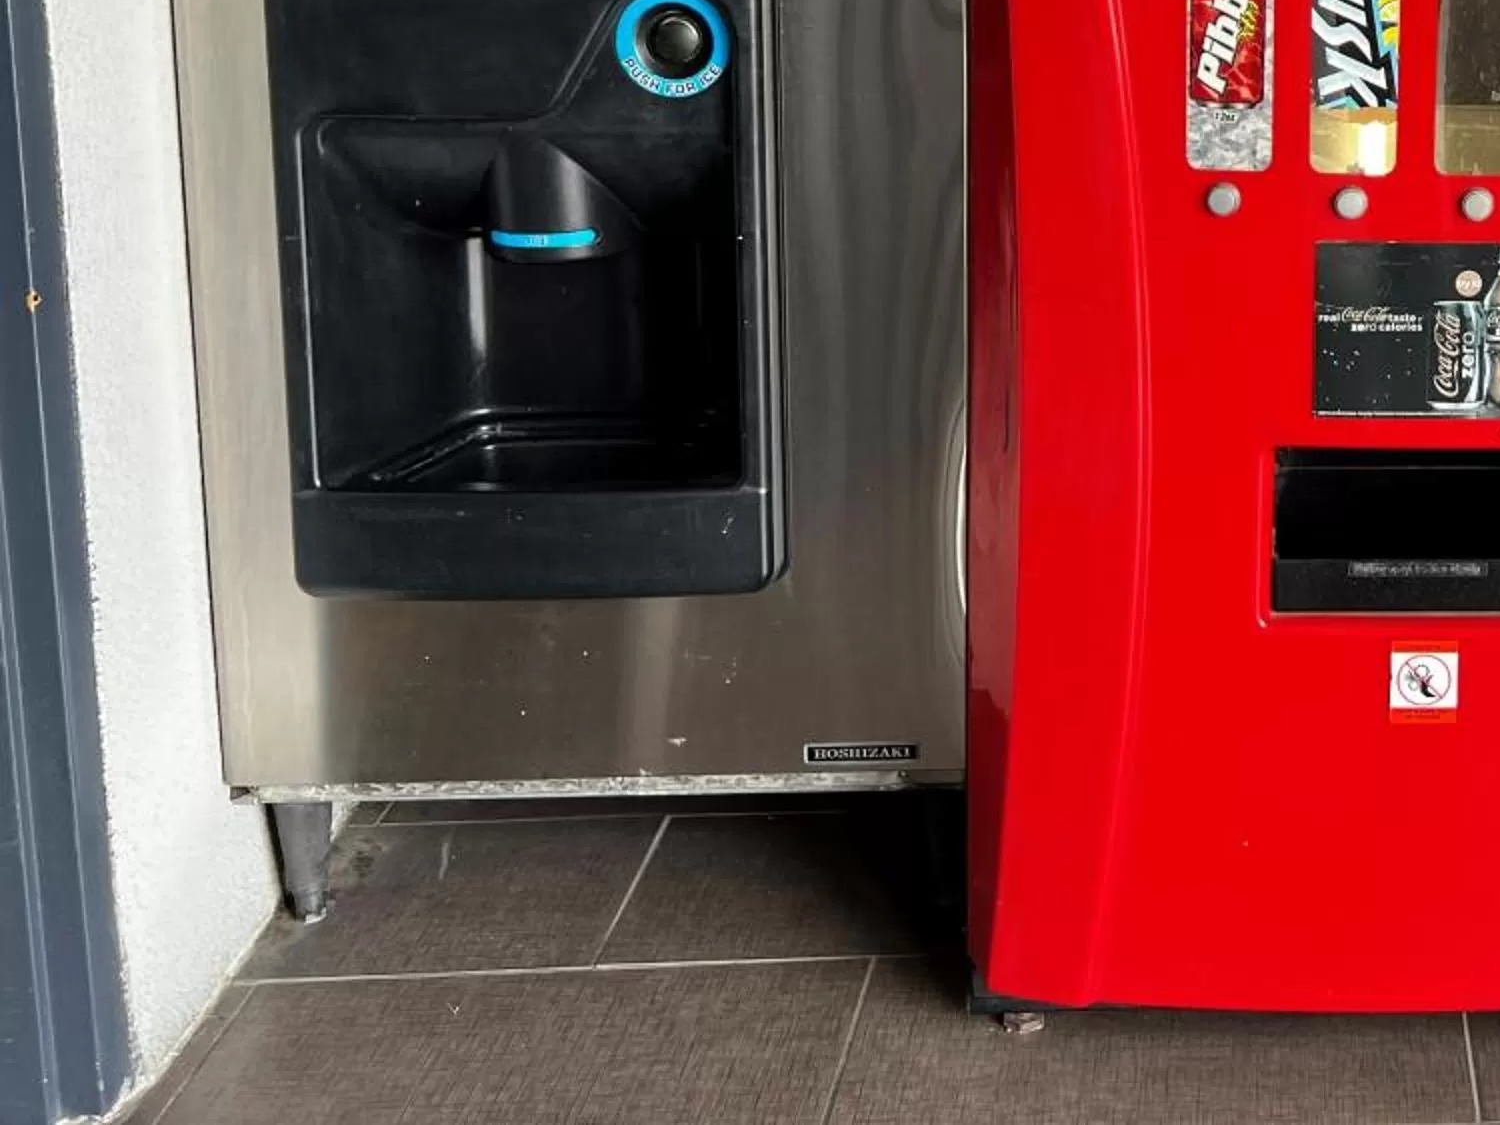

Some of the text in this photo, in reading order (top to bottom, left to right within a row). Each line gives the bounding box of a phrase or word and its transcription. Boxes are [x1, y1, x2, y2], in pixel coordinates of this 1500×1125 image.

[625, 58, 721, 94] PUSH FOR ICE
[1318, 313, 1340, 322] real
[1350, 322, 1423, 332] zero calories
[1463, 332, 1476, 379] zero
[813, 747, 911, 760] HOSHIZAKI
